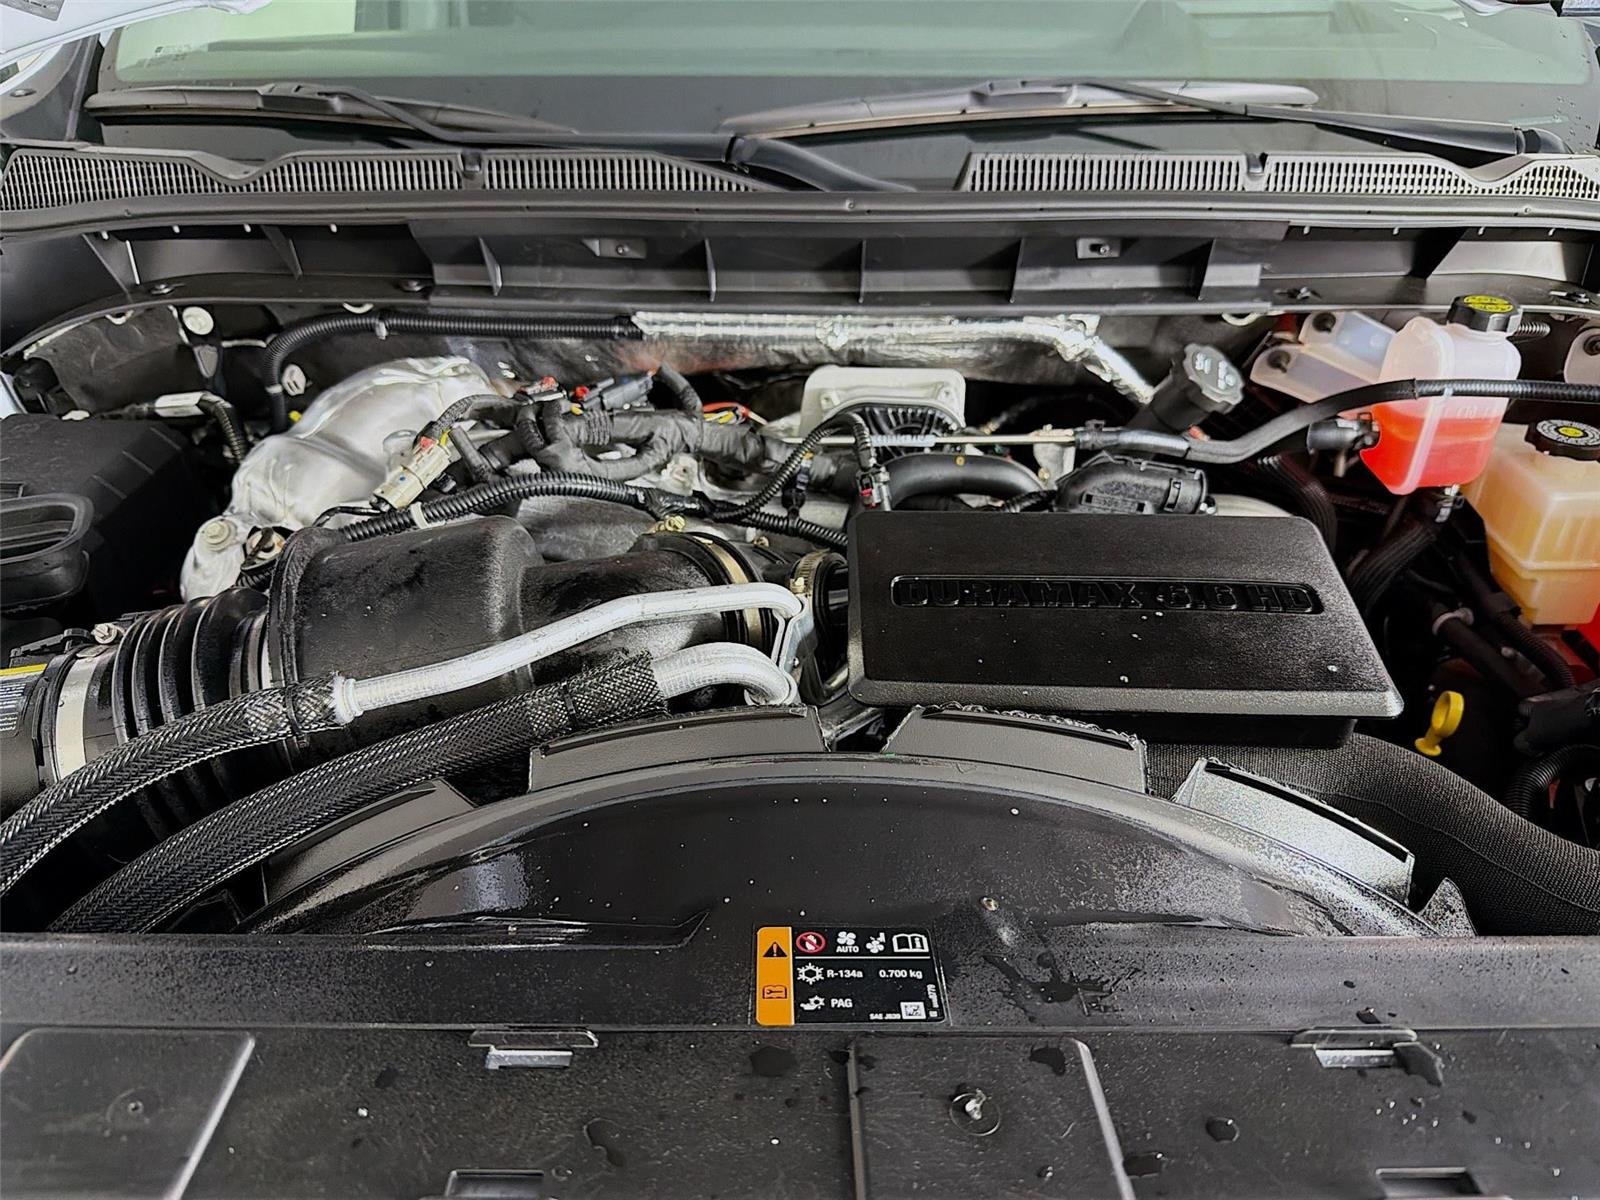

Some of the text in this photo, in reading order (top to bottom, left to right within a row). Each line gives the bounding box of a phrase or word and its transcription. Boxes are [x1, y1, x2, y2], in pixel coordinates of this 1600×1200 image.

[900, 579, 1143, 608] DURAMAX
[1245, 585, 1314, 612] HD
[836, 945, 860, 953] AUTO
[826, 969, 923, 979] R-134a 0.700 kg
[830, 998, 853, 1008] PAG
